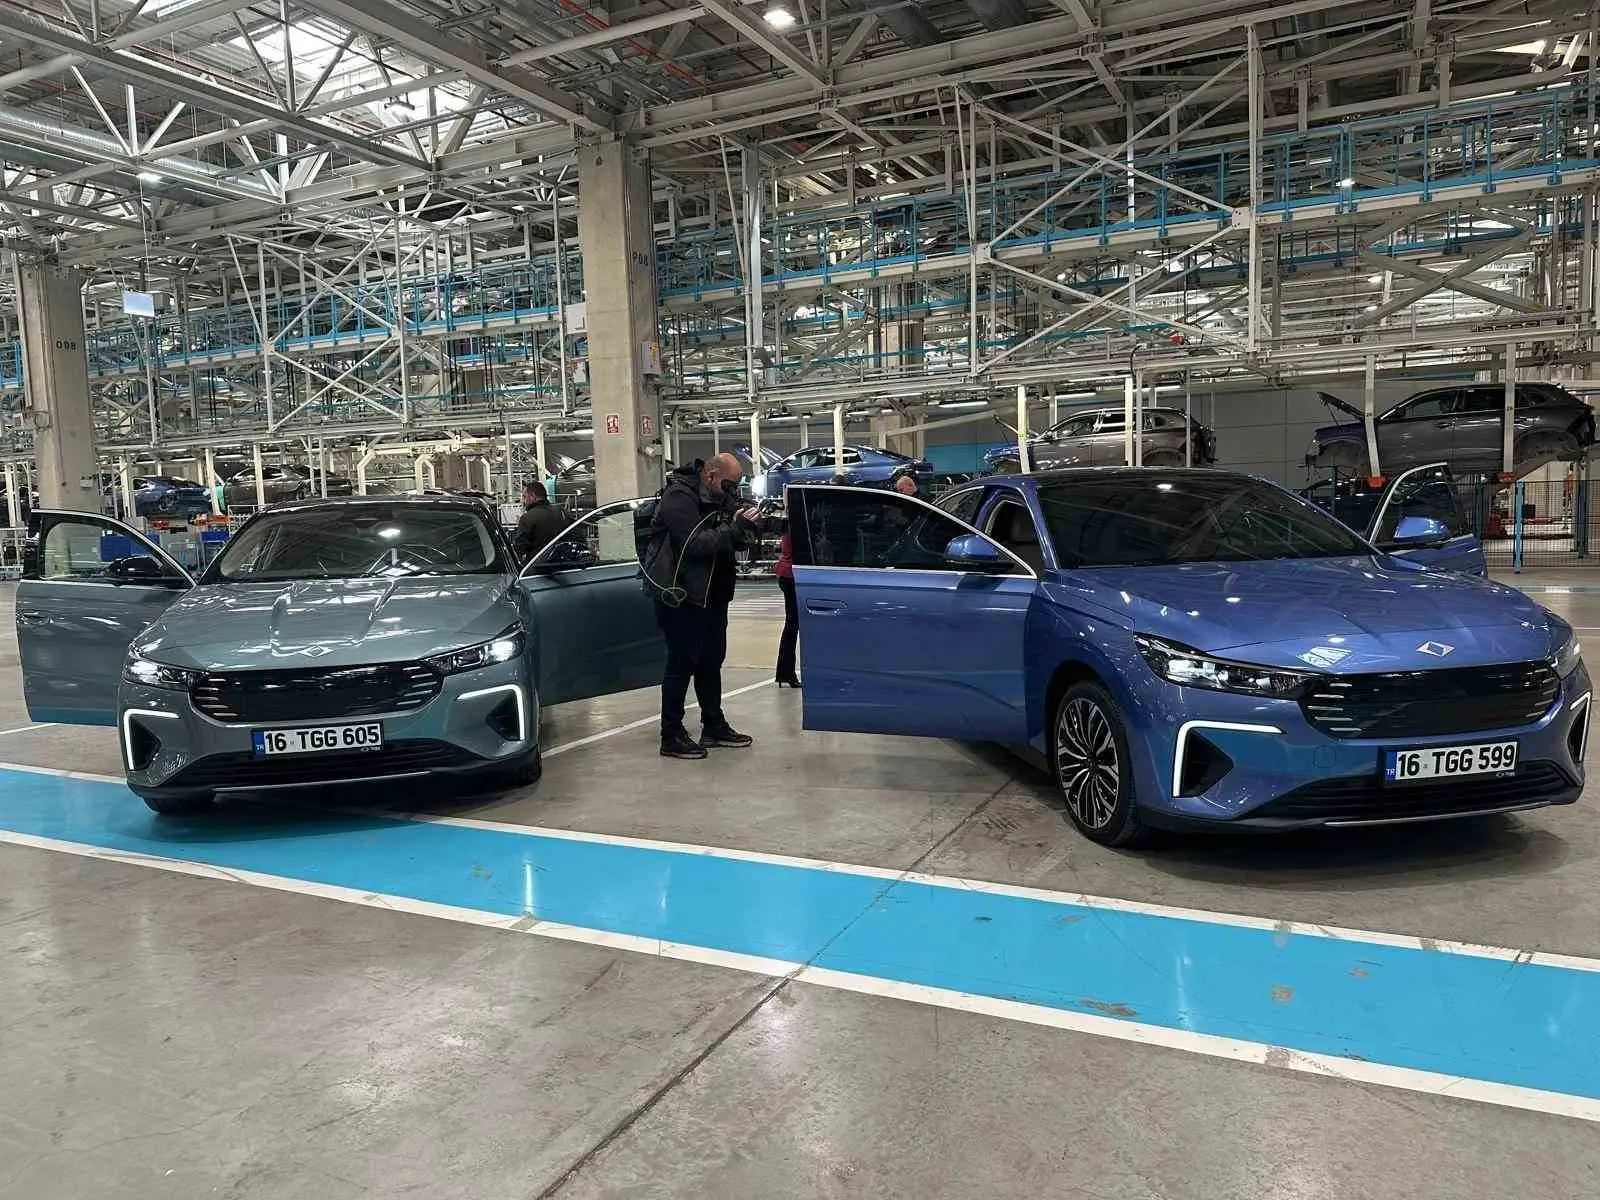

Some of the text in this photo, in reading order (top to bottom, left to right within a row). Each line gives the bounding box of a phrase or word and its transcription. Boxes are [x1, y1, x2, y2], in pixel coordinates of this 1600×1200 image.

[265, 726, 379, 752] 16 TGG 605
[1398, 744, 1515, 777] 16 TGG 599
